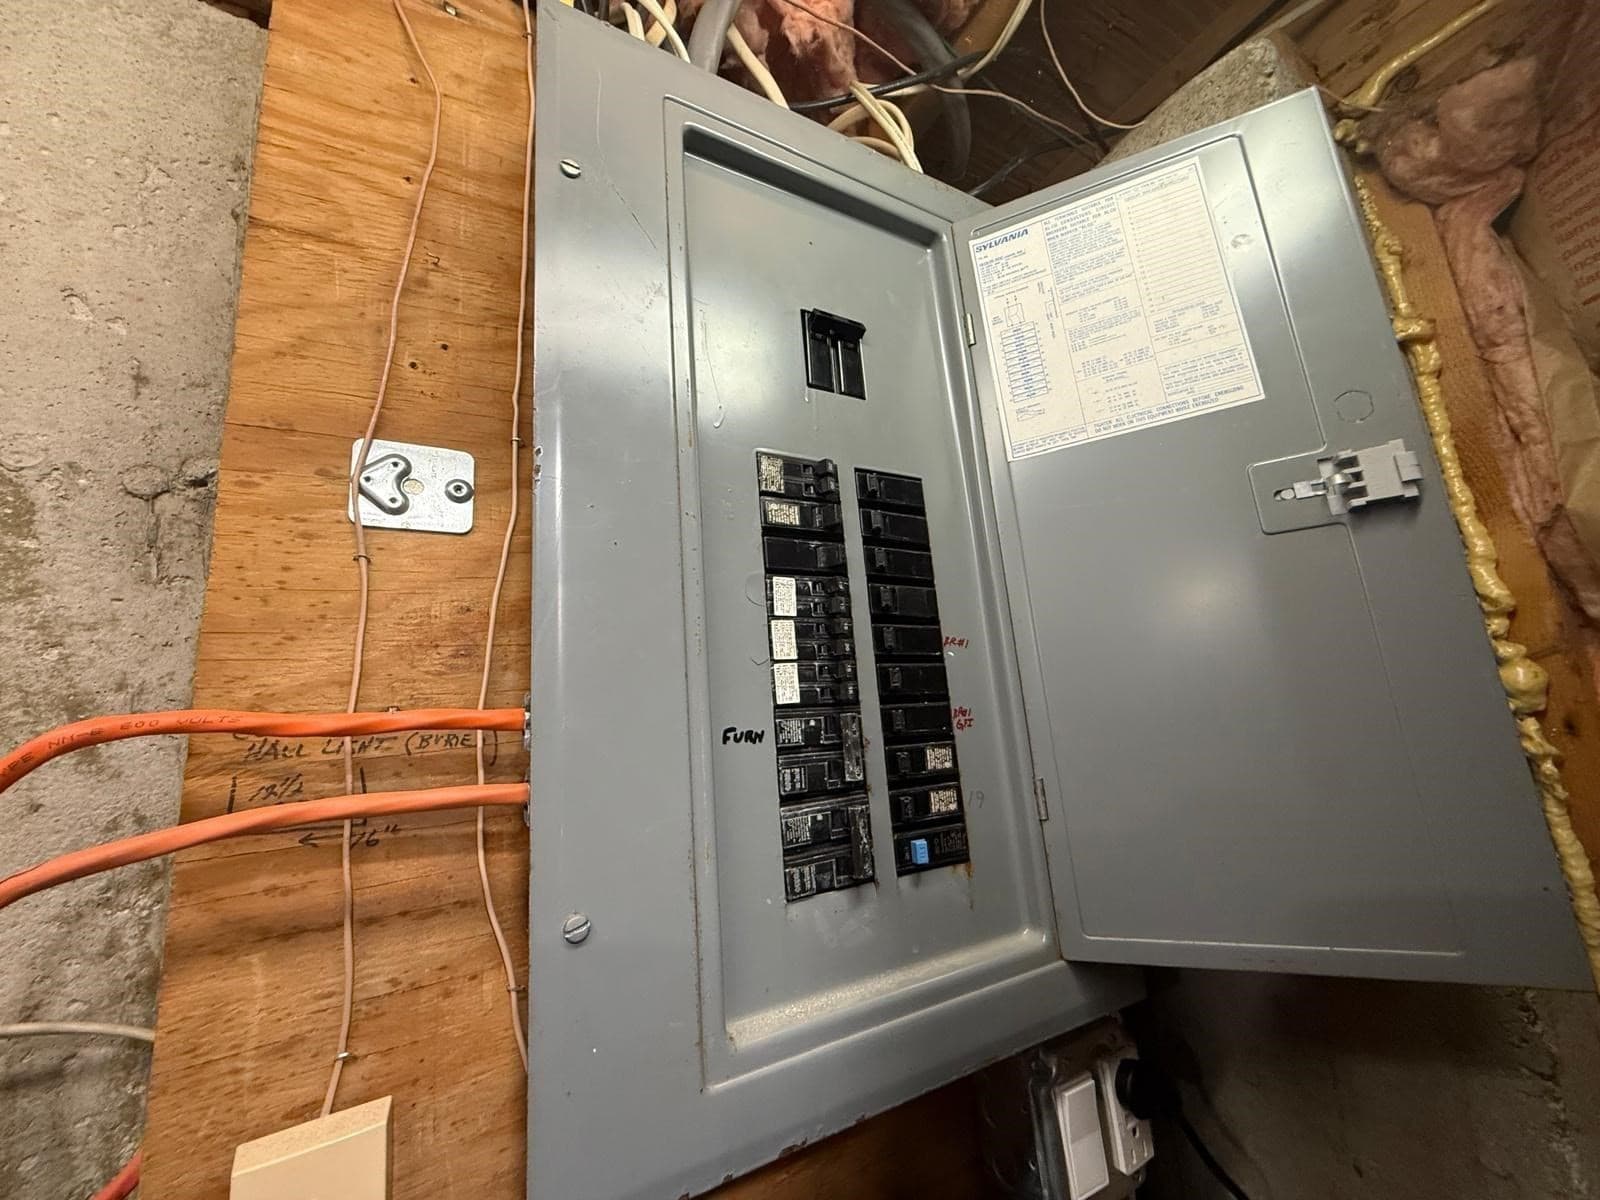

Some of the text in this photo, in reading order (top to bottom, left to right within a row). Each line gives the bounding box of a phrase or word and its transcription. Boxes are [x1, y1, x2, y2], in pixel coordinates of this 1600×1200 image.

[976, 229, 1029, 253] SYLVANIA
[1156, 400, 1189, 412] CONNECTIONS
[120, 719, 159, 730] 600
[177, 715, 243, 725] VOLTS
[722, 726, 765, 745] FURN
[246, 737, 307, 761] HALL
